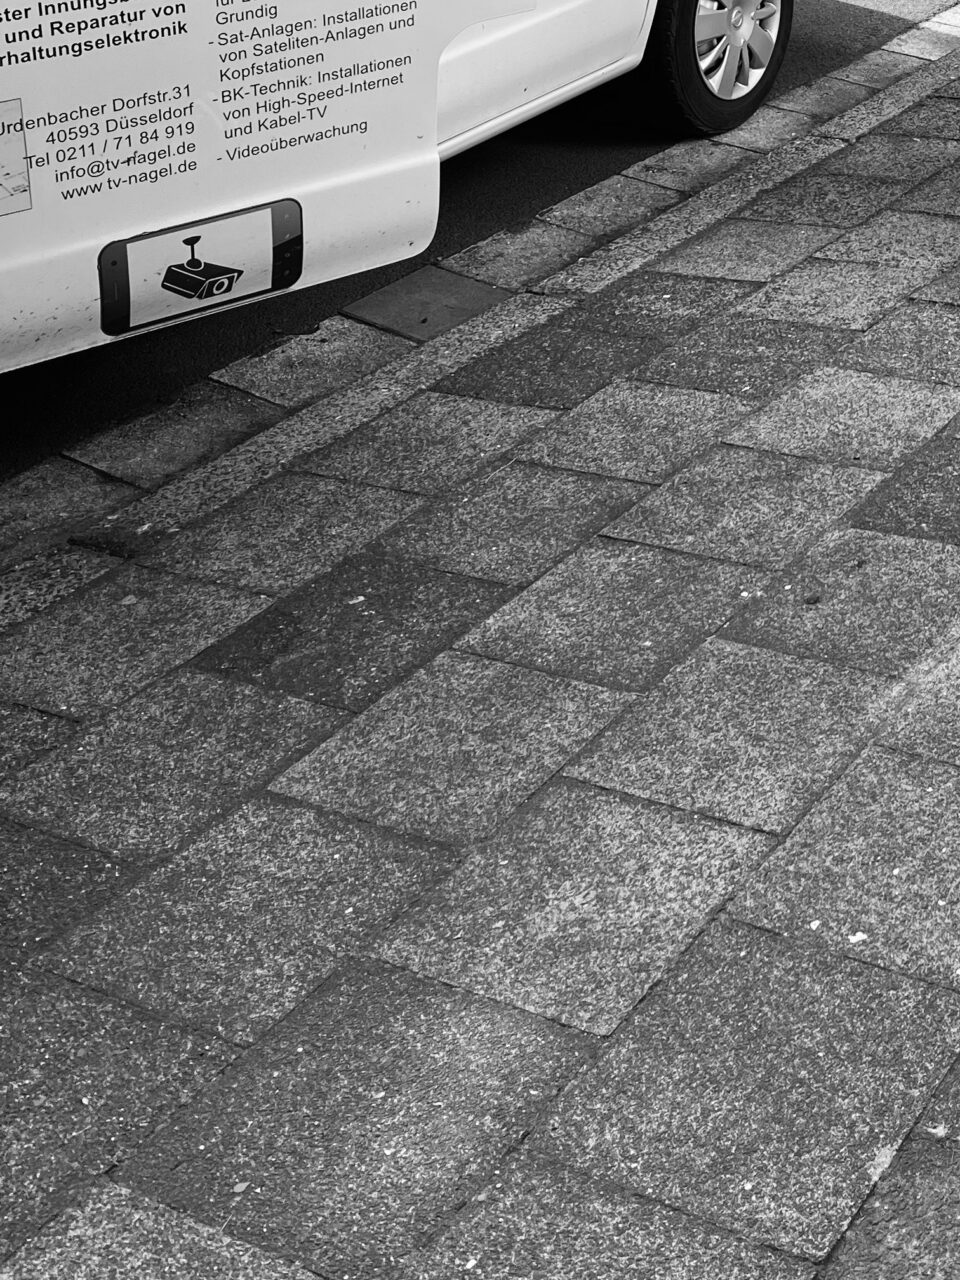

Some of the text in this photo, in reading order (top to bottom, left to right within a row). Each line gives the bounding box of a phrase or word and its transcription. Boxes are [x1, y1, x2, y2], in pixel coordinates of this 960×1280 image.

[4, 3, 186, 44] und Reparatur von
[215, 4, 278, 25] Grundig
[217, 19, 317, 46] Sat-Anlagen:
[322, 0, 418, 26] Installationen
[0, 20, 188, 67] rhaltungselektronik
[219, 14, 415, 63] von Sateliten-Anlagen und
[219, 52, 324, 82] Kopfstationen
[221, 75, 312, 103] BK-Technik:
[318, 55, 412, 83] Installationen
[112, 84, 191, 112] Dorfstr.31
[222, 72, 405, 121] von High-Speed-Internet
[46, 102, 195, 144] 40593 Düsseldorf
[224, 105, 328, 139] und Kabel-TV
[225, 120, 368, 161] Videoüberwachung
[23, 152, 50, 169] Tel
[56, 142, 95, 163] 0211
[113, 134, 132, 150] 71
[139, 129, 159, 145] 84
[165, 121, 195, 139] 919
[55, 141, 196, 183] info@tv-nagel.de
